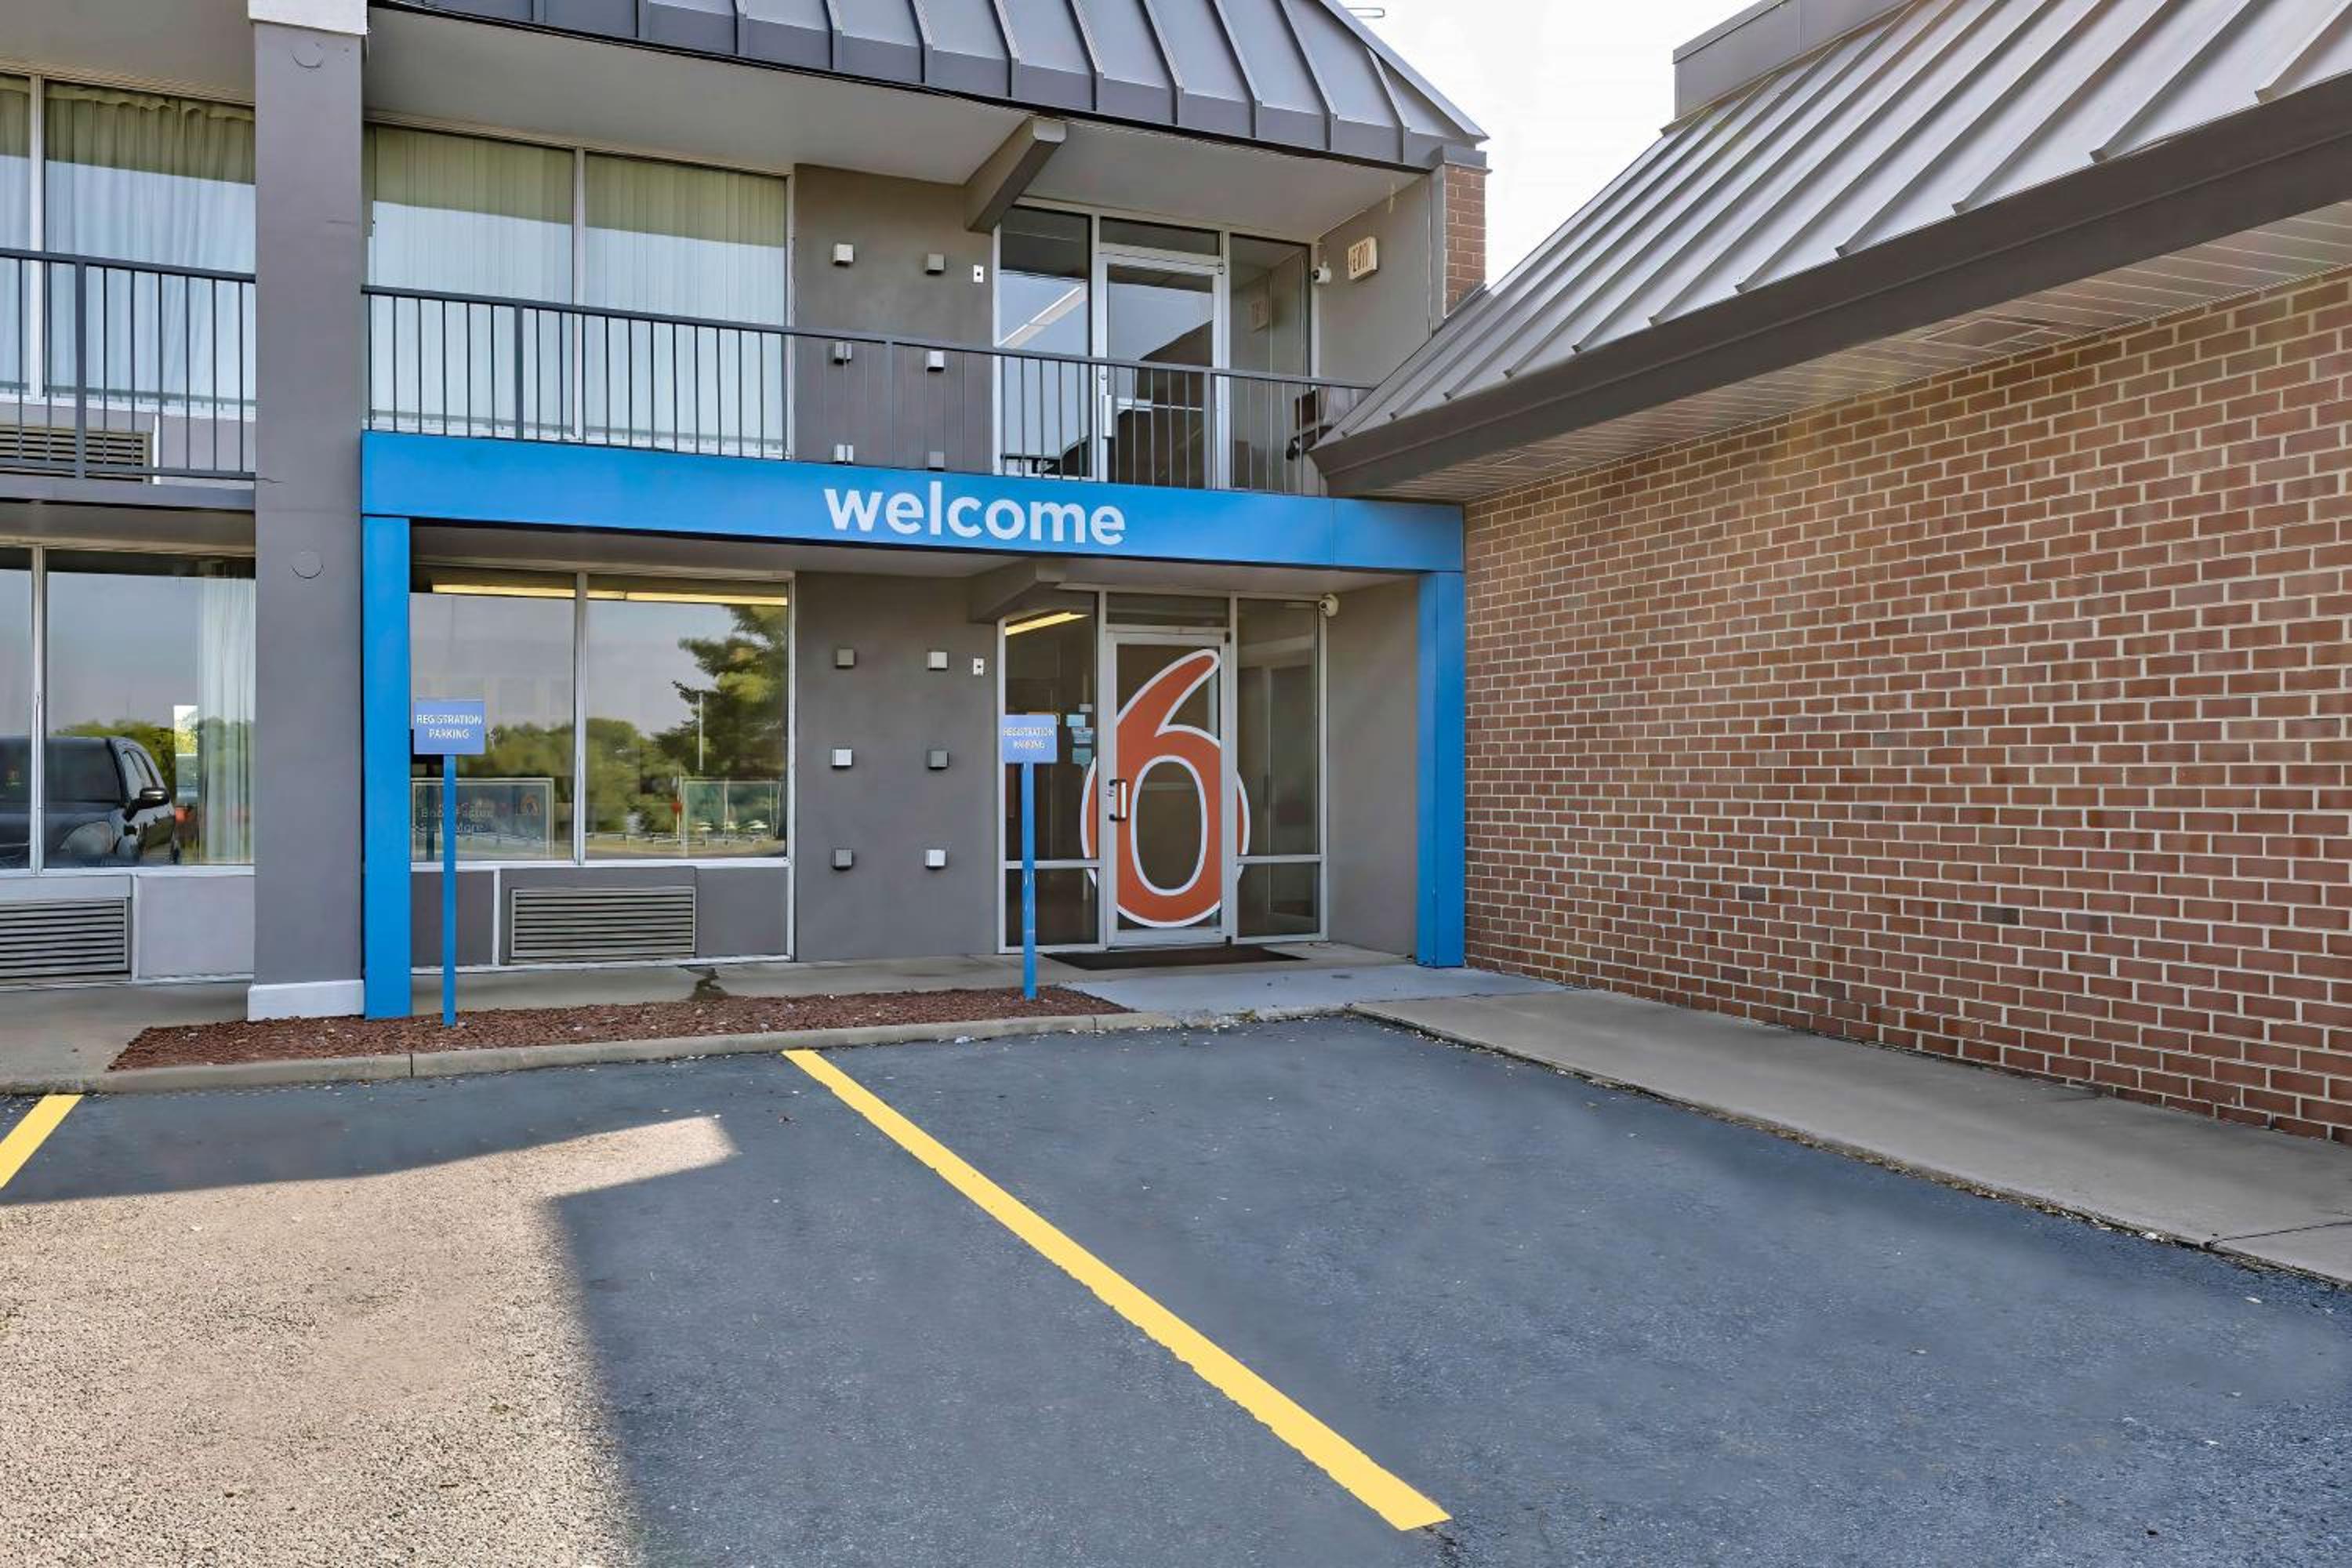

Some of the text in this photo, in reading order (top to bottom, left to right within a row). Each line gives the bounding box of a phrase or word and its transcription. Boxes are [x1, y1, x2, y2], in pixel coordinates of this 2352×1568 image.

[824, 481, 1126, 546] welcome
[416, 714, 482, 725] REGISTRATION
[428, 728, 470, 739] PARKING
[1080, 648, 1250, 927] 6
